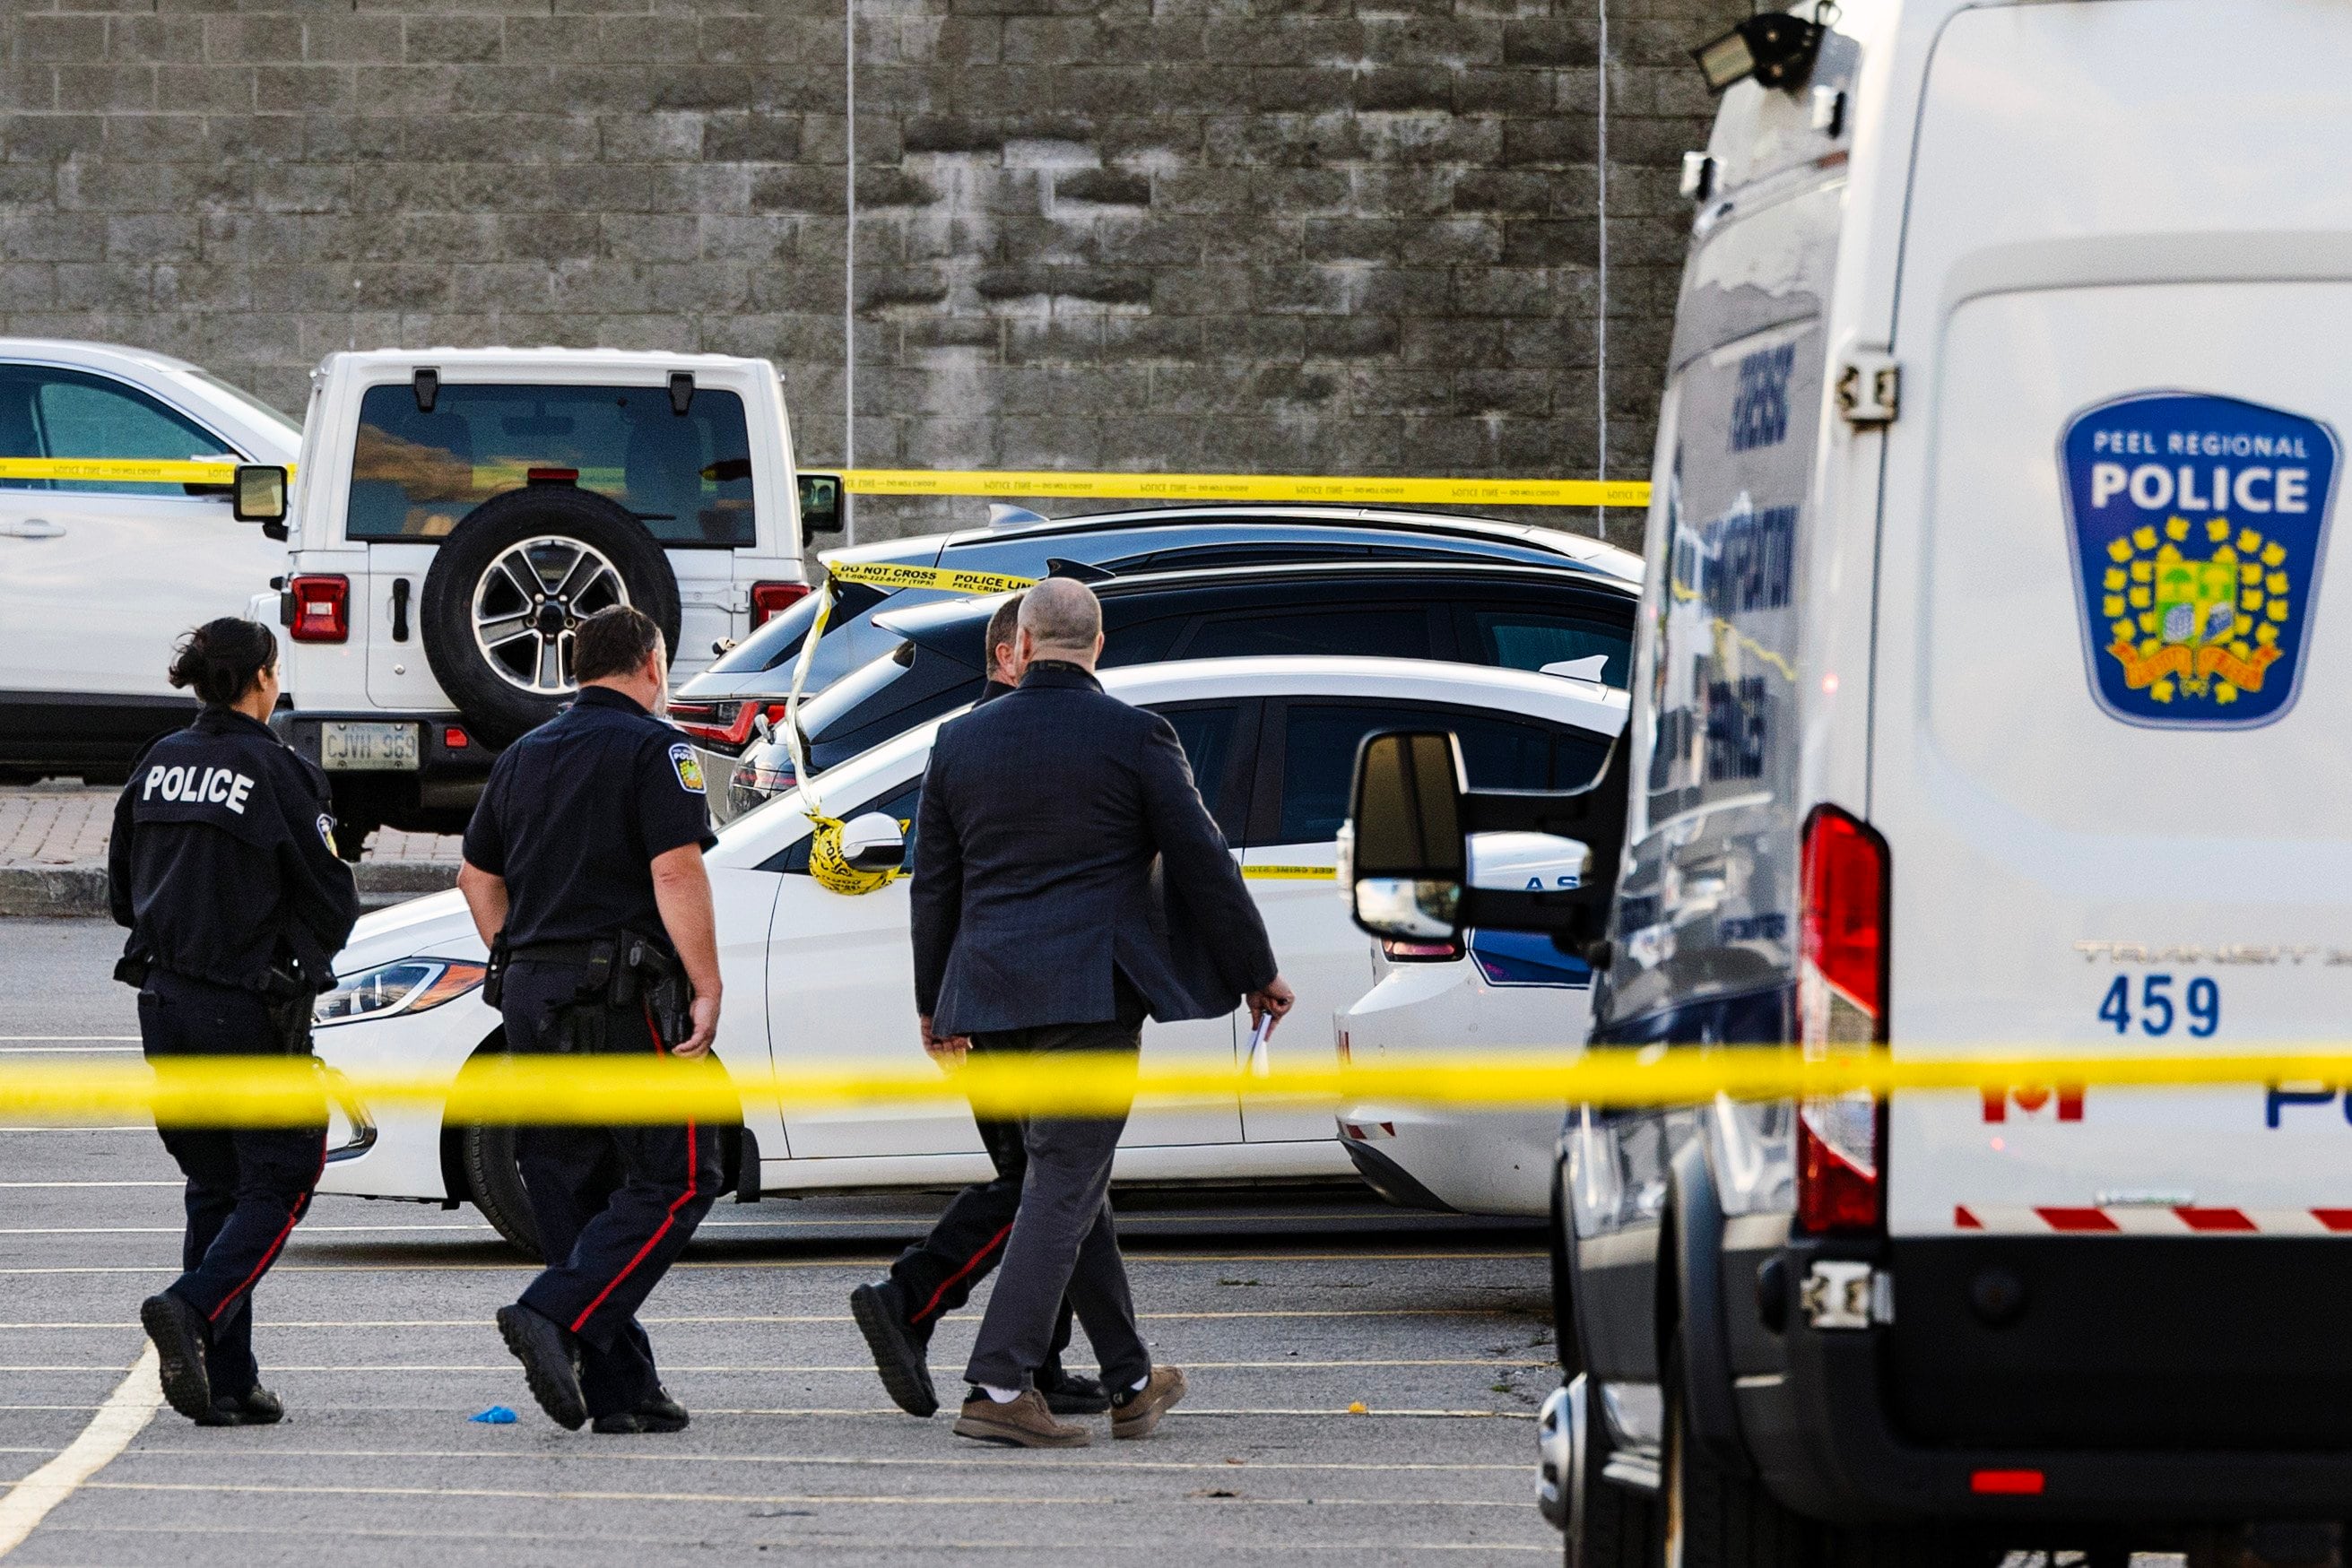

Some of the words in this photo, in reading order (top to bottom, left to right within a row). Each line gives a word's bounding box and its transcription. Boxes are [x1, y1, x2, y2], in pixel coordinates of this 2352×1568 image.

[2094, 431, 2157, 454] PEEL
[2168, 434, 2309, 459] REGIONAL
[2090, 463, 2310, 514] POLICE
[864, 567, 890, 576] NOT
[893, 568, 938, 580] CROSS
[952, 582, 974, 590] PEEL
[954, 574, 1004, 587] POLICE
[1007, 580, 1035, 590] LIN
[143, 766, 256, 815] POLICE
[2097, 973, 2221, 1038] 459
